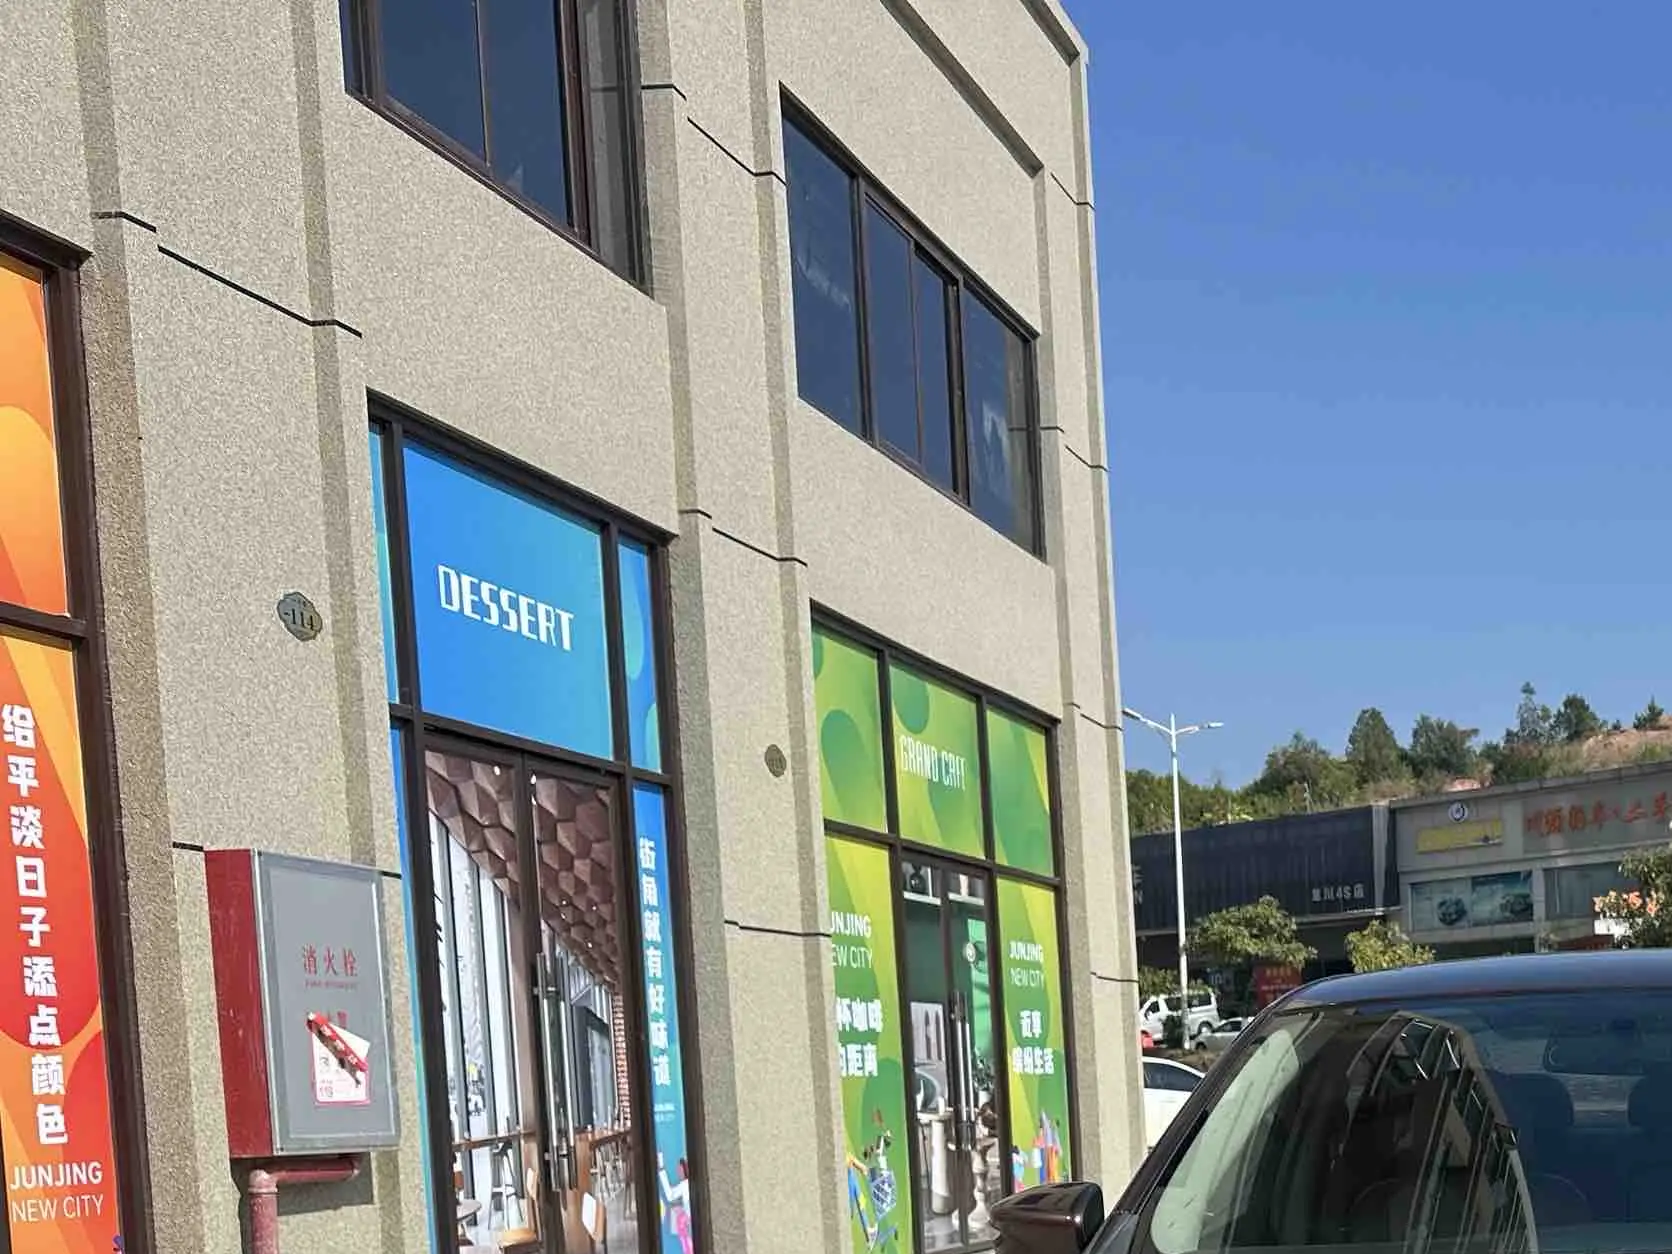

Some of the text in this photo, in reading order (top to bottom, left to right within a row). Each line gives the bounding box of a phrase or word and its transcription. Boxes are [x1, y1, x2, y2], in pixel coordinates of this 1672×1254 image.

[438, 564, 575, 651] DESSERT
[900, 734, 939, 782] GRAND
[2, 703, 69, 1146] 给平淡日子添点颜色
[303, 944, 358, 977] 消火栓
[639, 836, 672, 1088] 街角就有好味道
[832, 943, 848, 967] EW
[836, 996, 883, 1033] 杯咖啡
[9, 1160, 103, 1191] JUNJING
[11, 1193, 104, 1224] NEW CITY
